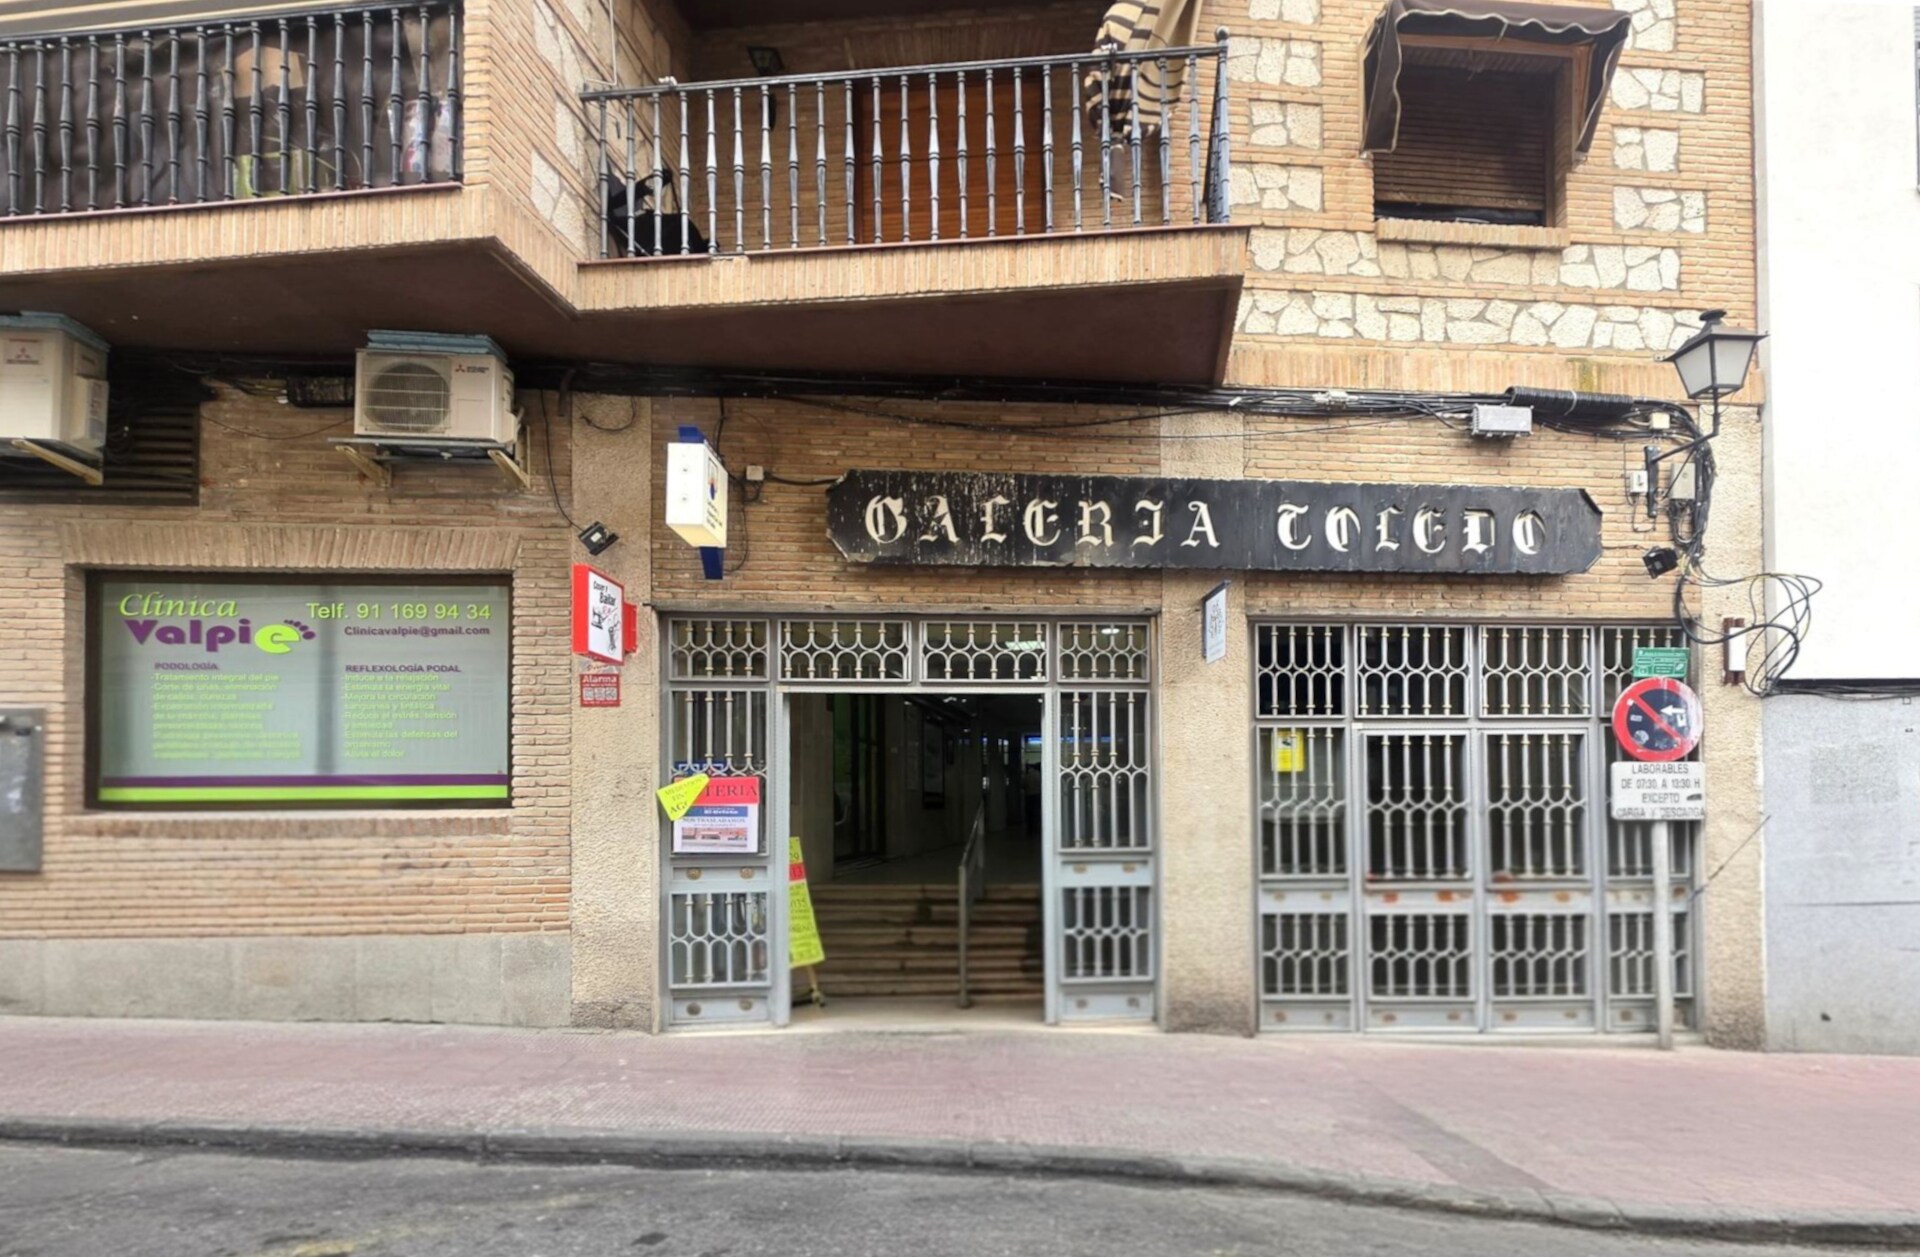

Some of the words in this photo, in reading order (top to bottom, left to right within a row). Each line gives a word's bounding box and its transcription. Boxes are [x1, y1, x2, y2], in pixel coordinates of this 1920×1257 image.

[864, 493, 1221, 548] GALERIA
[1276, 502, 1547, 555] TOLEDO
[306, 603, 349, 619] Telf.
[356, 603, 381, 619] 91
[390, 603, 428, 619] 169
[434, 603, 460, 619] 94
[466, 603, 491, 619] 34
[124, 618, 301, 654] Valpie
[426, 665, 462, 673] PODAL
[1632, 763, 1689, 774] LABORABLES
[1621, 778, 1632, 789] DE
[1661, 778, 1667, 789] A
[1642, 792, 1680, 803] EXCEPTO
